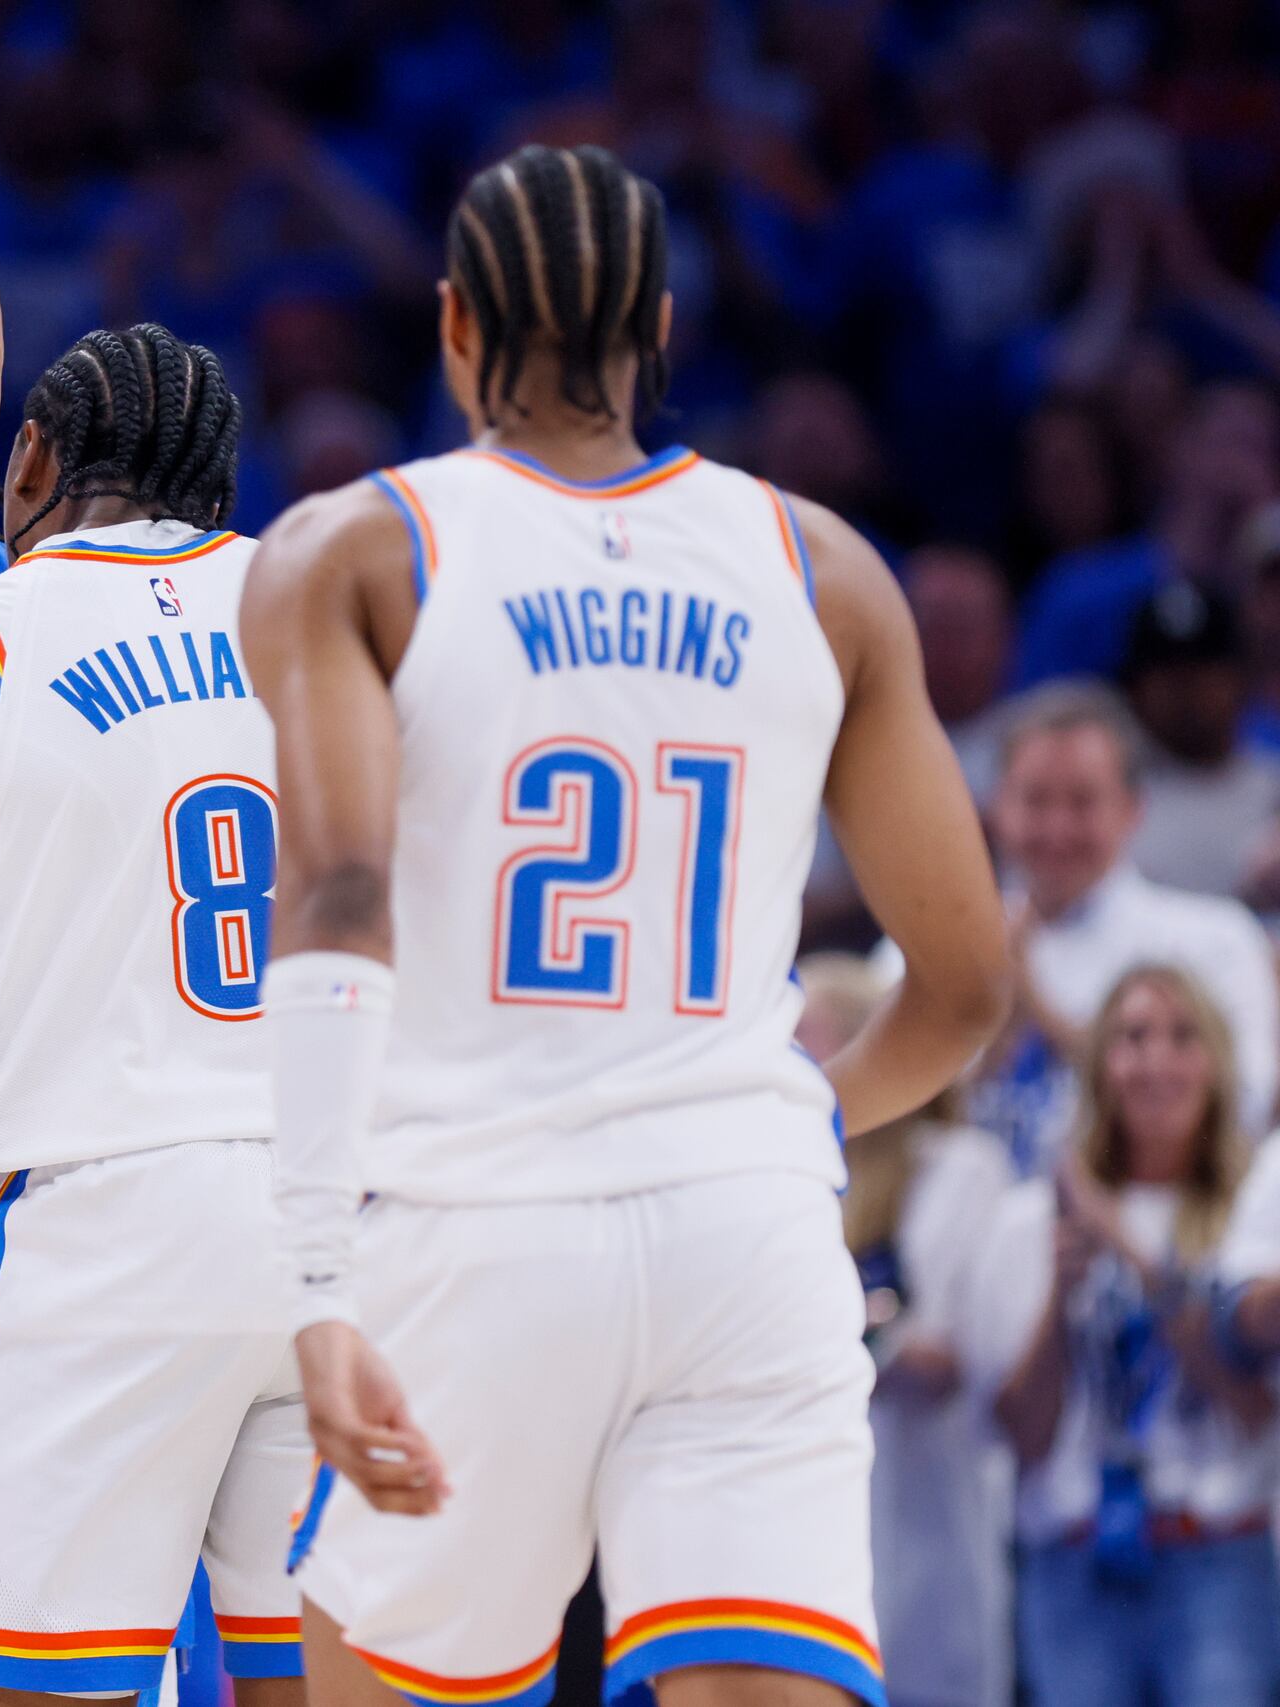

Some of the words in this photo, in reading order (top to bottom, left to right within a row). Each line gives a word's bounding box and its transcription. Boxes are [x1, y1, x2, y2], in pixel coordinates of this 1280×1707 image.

[49, 631, 258, 735] WILLIA
[502, 588, 751, 689] WIGGINS
[163, 773, 280, 1022] 8
[491, 735, 747, 1018] 21
